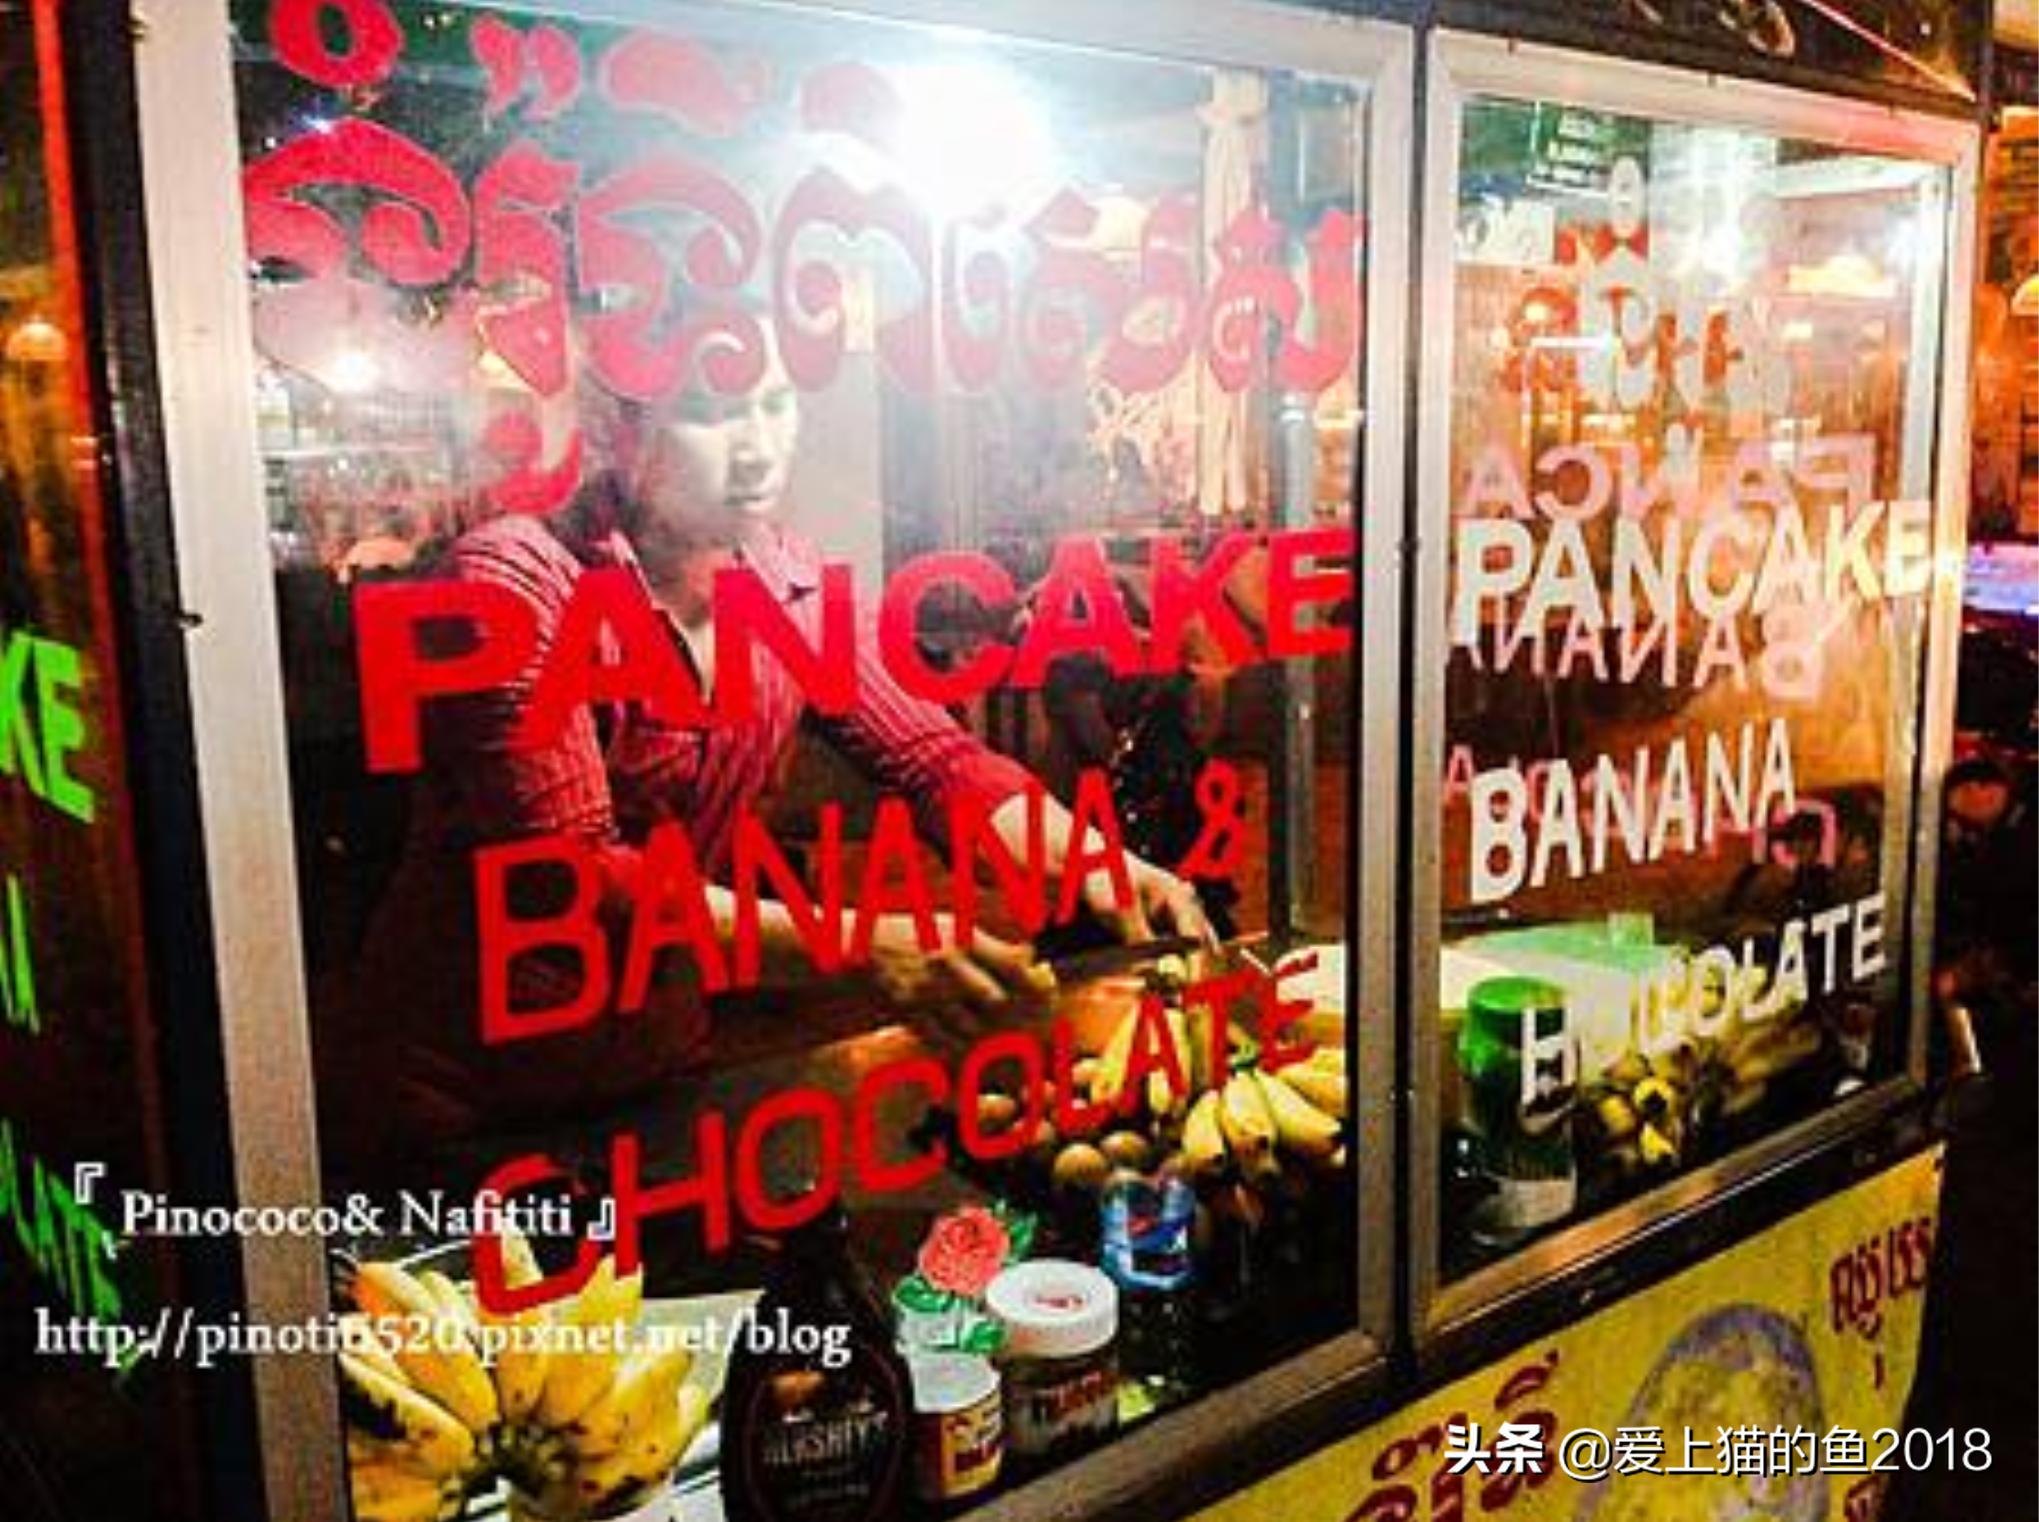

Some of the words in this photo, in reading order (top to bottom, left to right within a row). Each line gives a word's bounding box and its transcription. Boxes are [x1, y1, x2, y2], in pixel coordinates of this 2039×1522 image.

[353, 526, 1352, 773] PANCAKE
[1450, 500, 1933, 648] PANCAKE
[472, 765, 1134, 1045] BANANA
[1181, 761, 1246, 883] &
[1470, 717, 1797, 904] BANANA
[472, 953, 1322, 1317] CHOCOLATE
